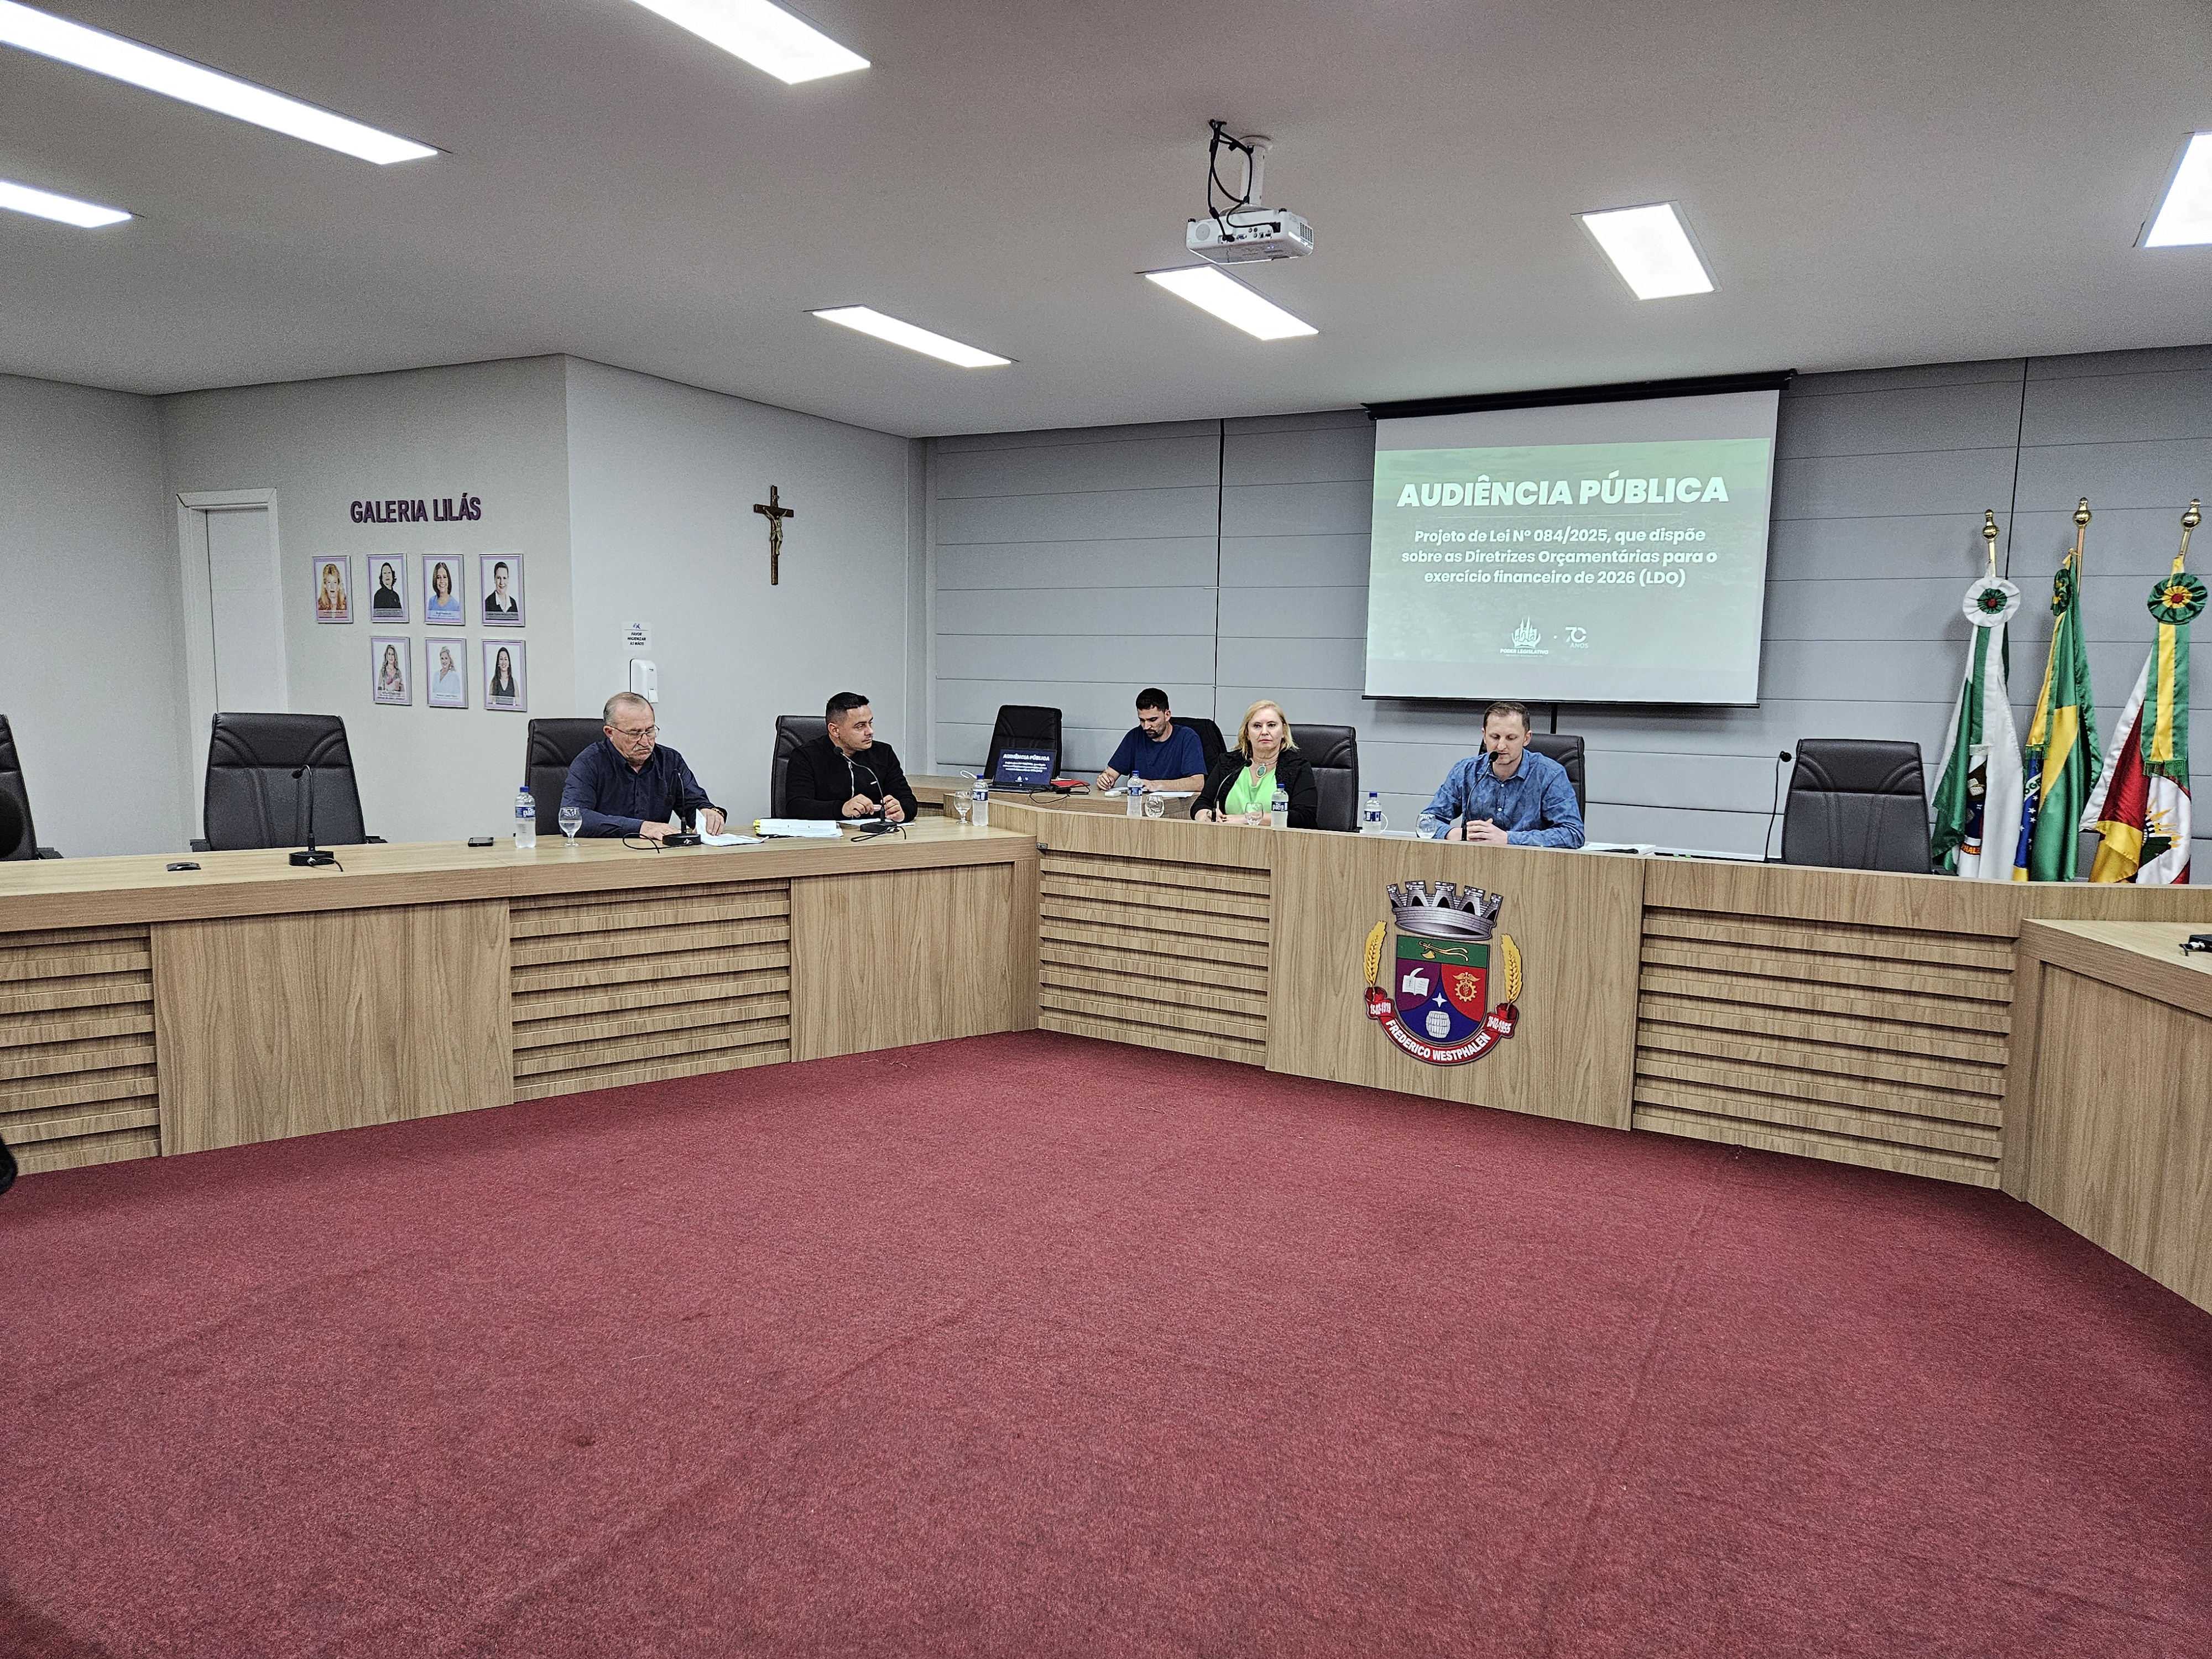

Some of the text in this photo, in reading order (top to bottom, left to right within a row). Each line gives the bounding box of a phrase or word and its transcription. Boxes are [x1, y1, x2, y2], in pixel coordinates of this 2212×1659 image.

[1396, 469, 1729, 507] AUDIÊNCIA PÚBLICA
[350, 493, 481, 523] GALERIA LILÁS
[1414, 529, 1466, 546] Projeto
[1468, 530, 1488, 542] de
[1489, 528, 1510, 542] Lei
[1533, 525, 1611, 545] 084/2025,
[1614, 530, 1647, 545] que
[1648, 527, 1706, 545] dispõe
[1401, 549, 1718, 567] sobre as Diretrizes Orçamentárias para o
[1424, 568, 1686, 588] exercício financeiro de 2026 (LDO)
[1385, 1019, 1491, 1061] FREDERICO WESTPHALEN
